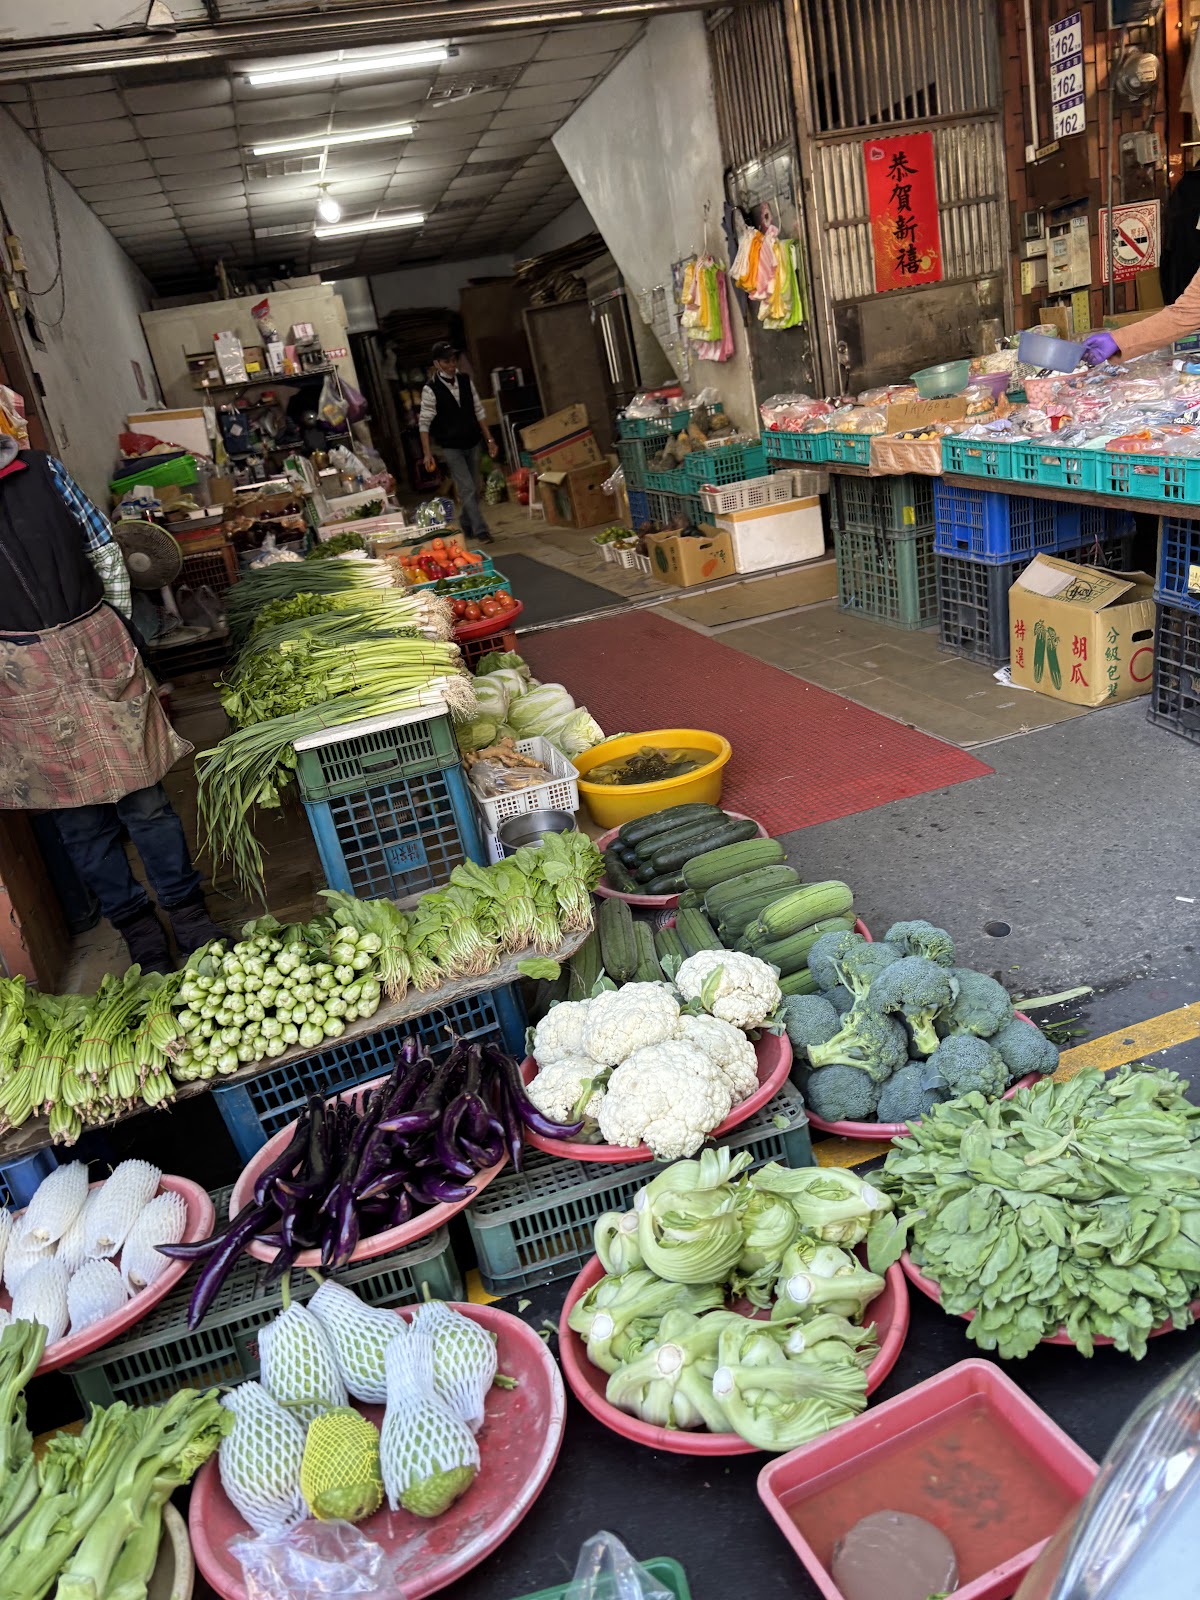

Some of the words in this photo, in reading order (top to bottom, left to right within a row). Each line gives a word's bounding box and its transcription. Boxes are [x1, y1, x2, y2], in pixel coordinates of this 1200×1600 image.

[1056, 33, 1074, 58] 162
[1058, 74, 1075, 97] 162
[1060, 113, 1077, 136] 162
[886, 151, 922, 275] 恭賀新禧
[1014, 619, 1026, 668] 特選
[1070, 635, 1089, 687] 胡瓜
[1105, 626, 1121, 699] 分級包裝
